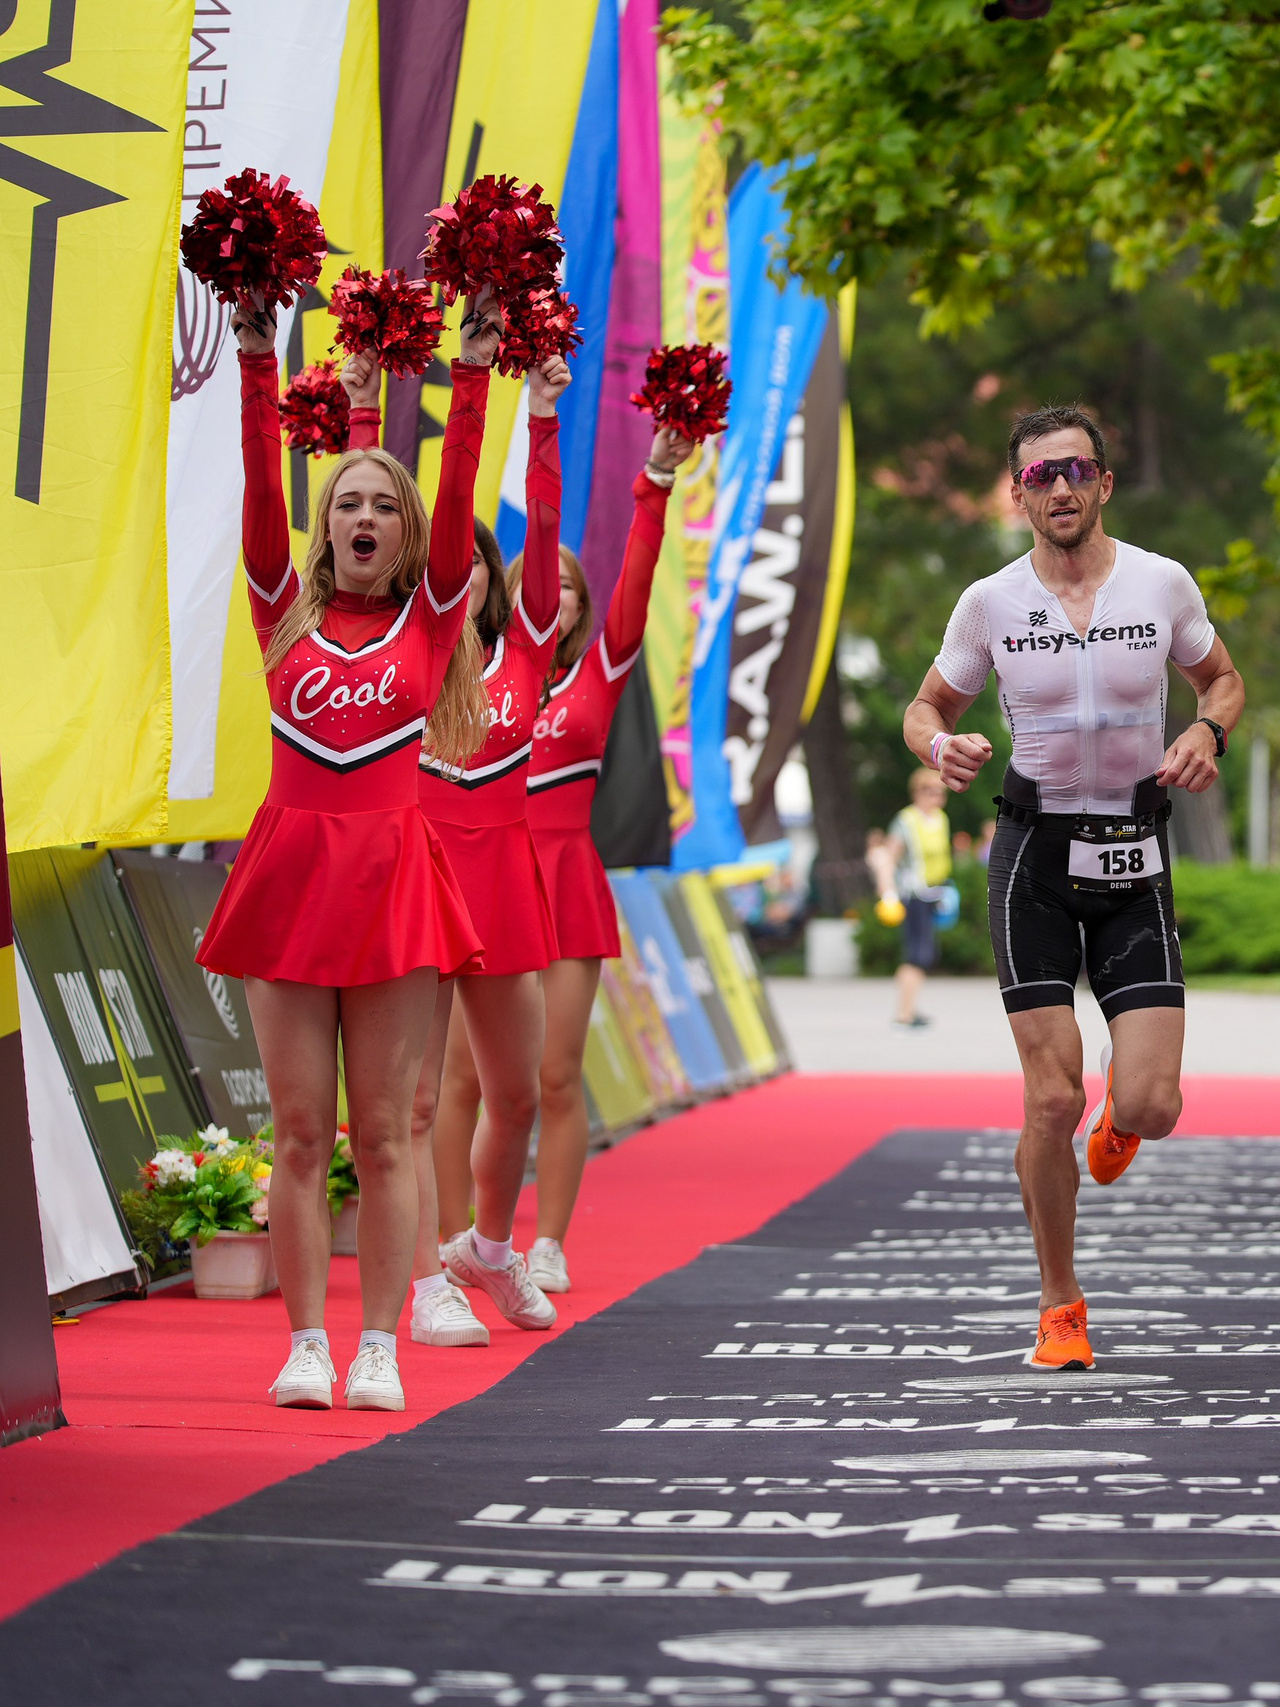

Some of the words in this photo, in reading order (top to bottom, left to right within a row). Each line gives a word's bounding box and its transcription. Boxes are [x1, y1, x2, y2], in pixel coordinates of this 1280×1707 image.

[1002, 622, 1157, 653] trisystems
[1126, 640, 1157, 651] TEAM
[291, 664, 397, 720] Cool
[1097, 848, 1145, 875] 158
[1110, 881, 1132, 890] DENIS
[54, 970, 116, 1065] IRON
[99, 968, 154, 1061] STAR
[710, 1343, 972, 1356] IRON
[615, 1417, 920, 1429] IRON
[473, 1503, 842, 1528] IRON
[383, 1559, 794, 1591] IRON
